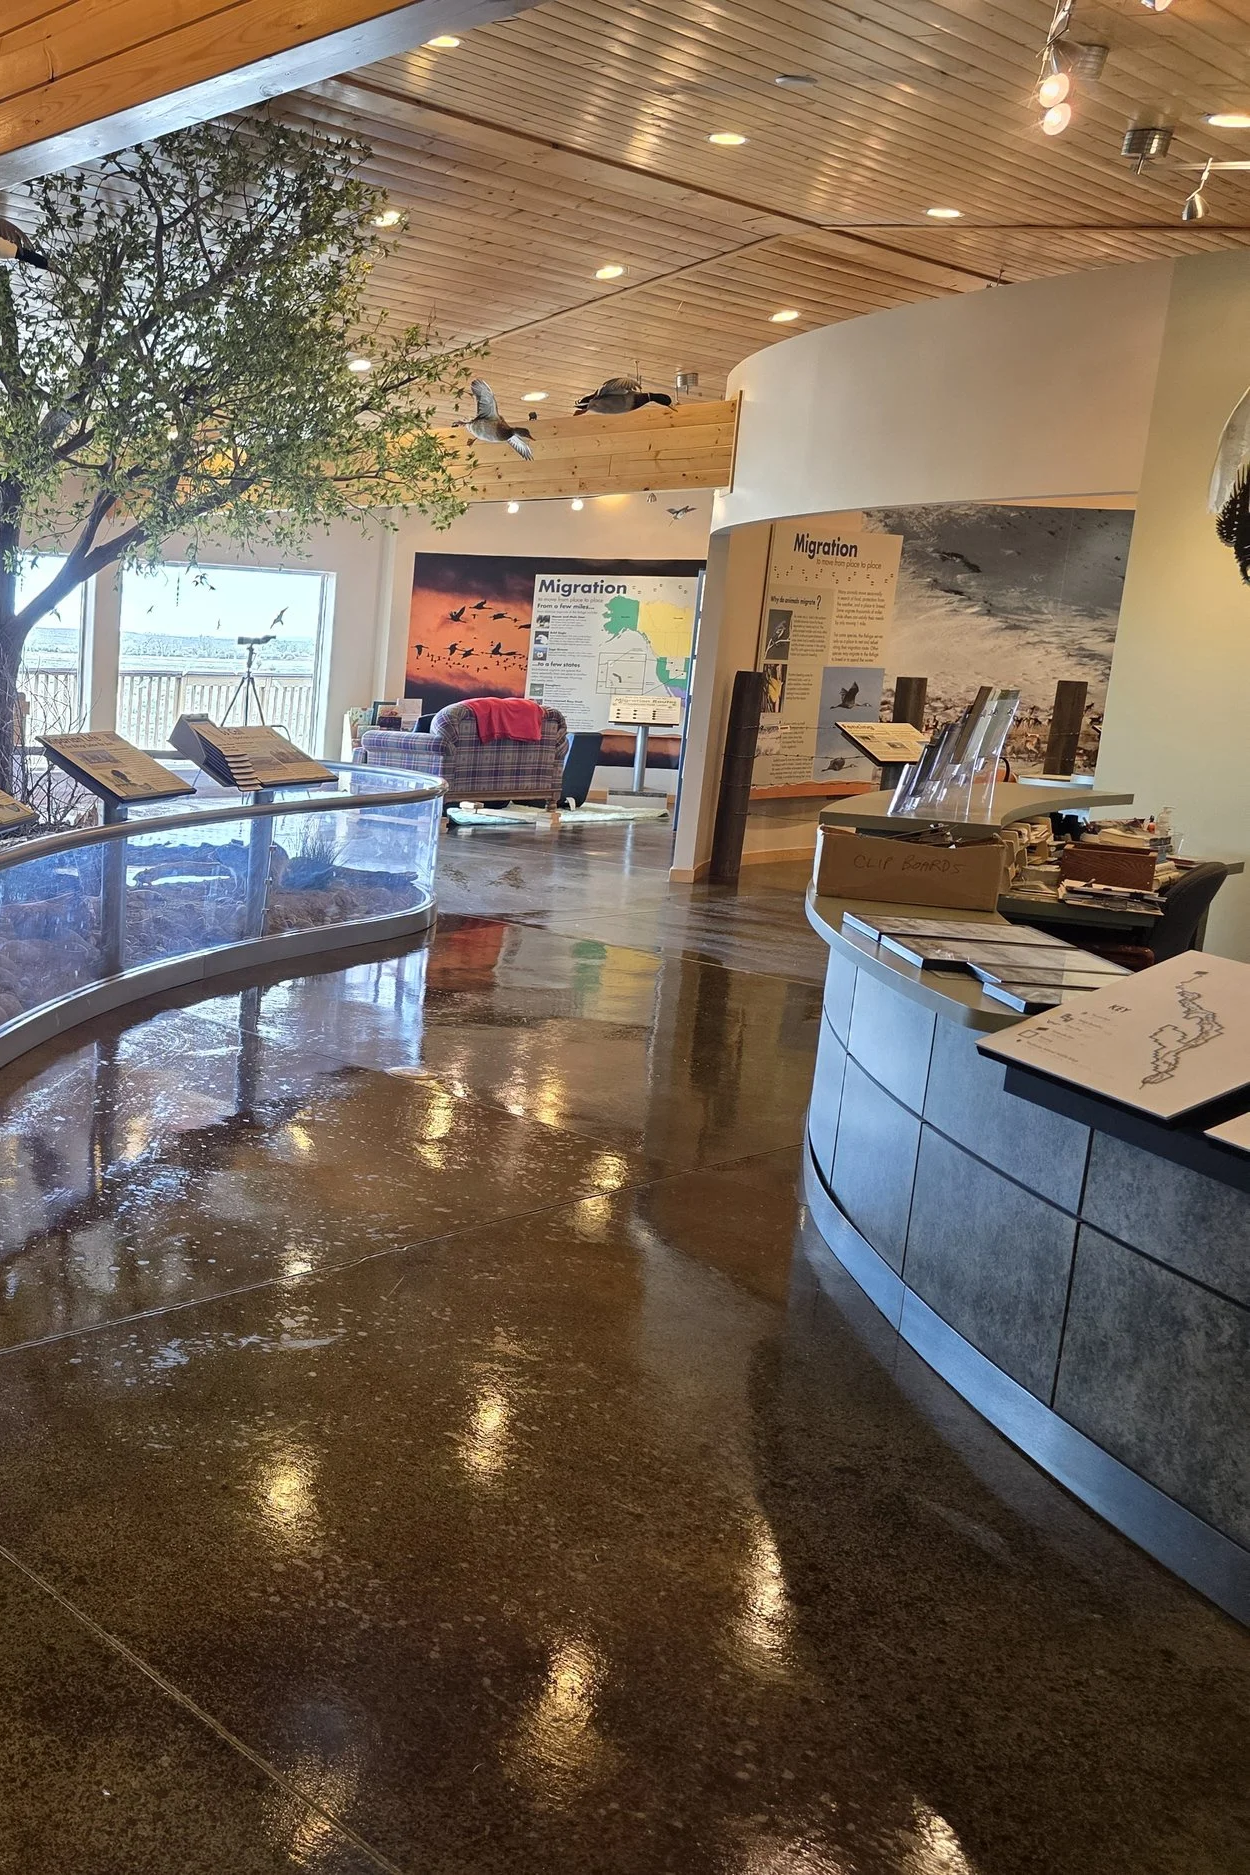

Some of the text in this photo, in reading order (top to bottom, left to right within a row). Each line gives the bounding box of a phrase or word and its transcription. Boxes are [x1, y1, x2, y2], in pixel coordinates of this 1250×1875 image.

[793, 533, 858, 559] Migration
[834, 558, 845, 566] from
[846, 559, 860, 569] place
[861, 560, 866, 568] to
[867, 560, 882, 570] place
[538, 579, 627, 597] Migration
[770, 595, 779, 604] Why
[853, 853, 966, 874] CLIP BOARDS
[1108, 1004, 1132, 1013] KEY
